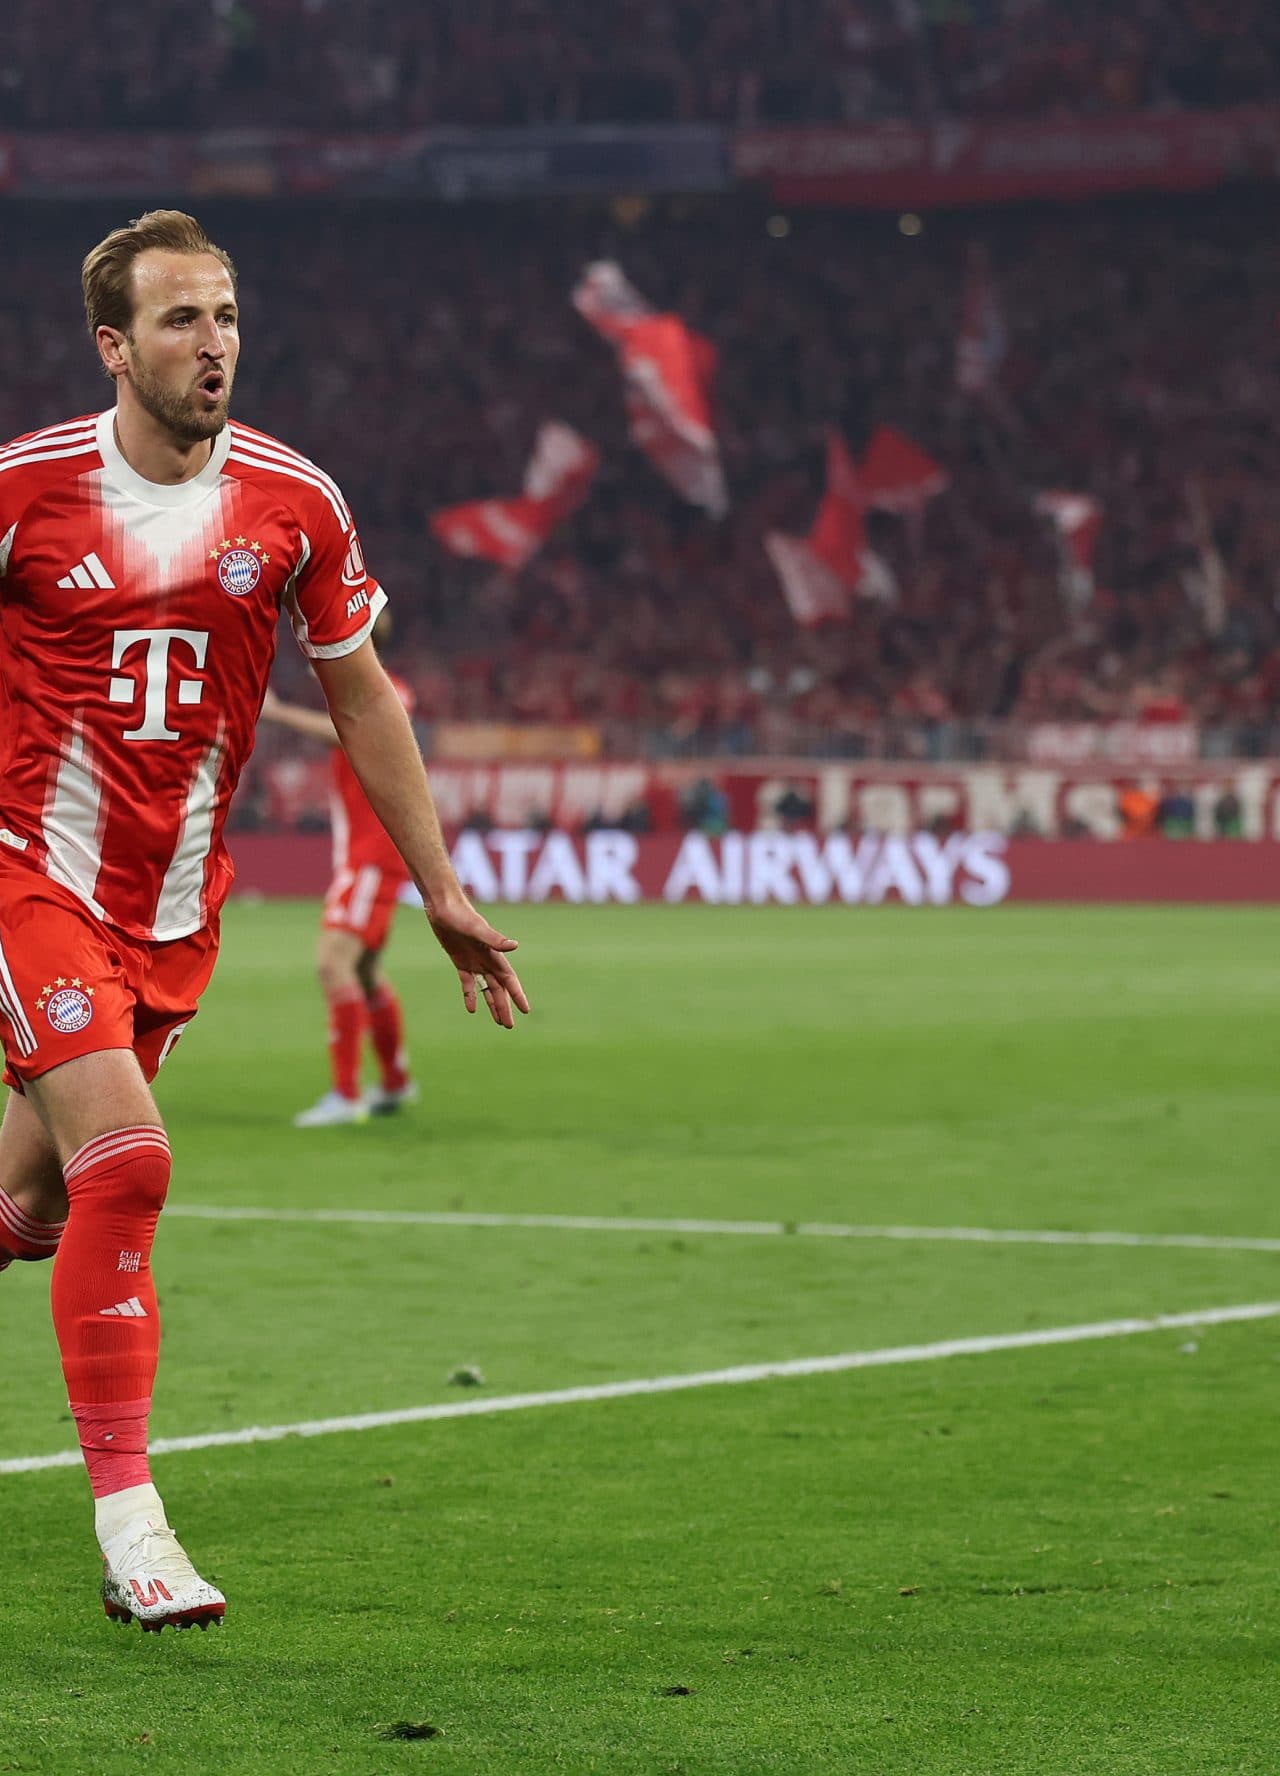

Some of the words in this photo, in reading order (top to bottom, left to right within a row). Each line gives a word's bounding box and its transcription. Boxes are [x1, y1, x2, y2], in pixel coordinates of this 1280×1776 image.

[231, 553, 258, 571] BAYERN
[109, 629, 209, 741] T
[399, 828, 642, 906] ATAR
[663, 829, 1011, 906] AIRWAYS
[56, 992, 86, 1005] BAYERN
